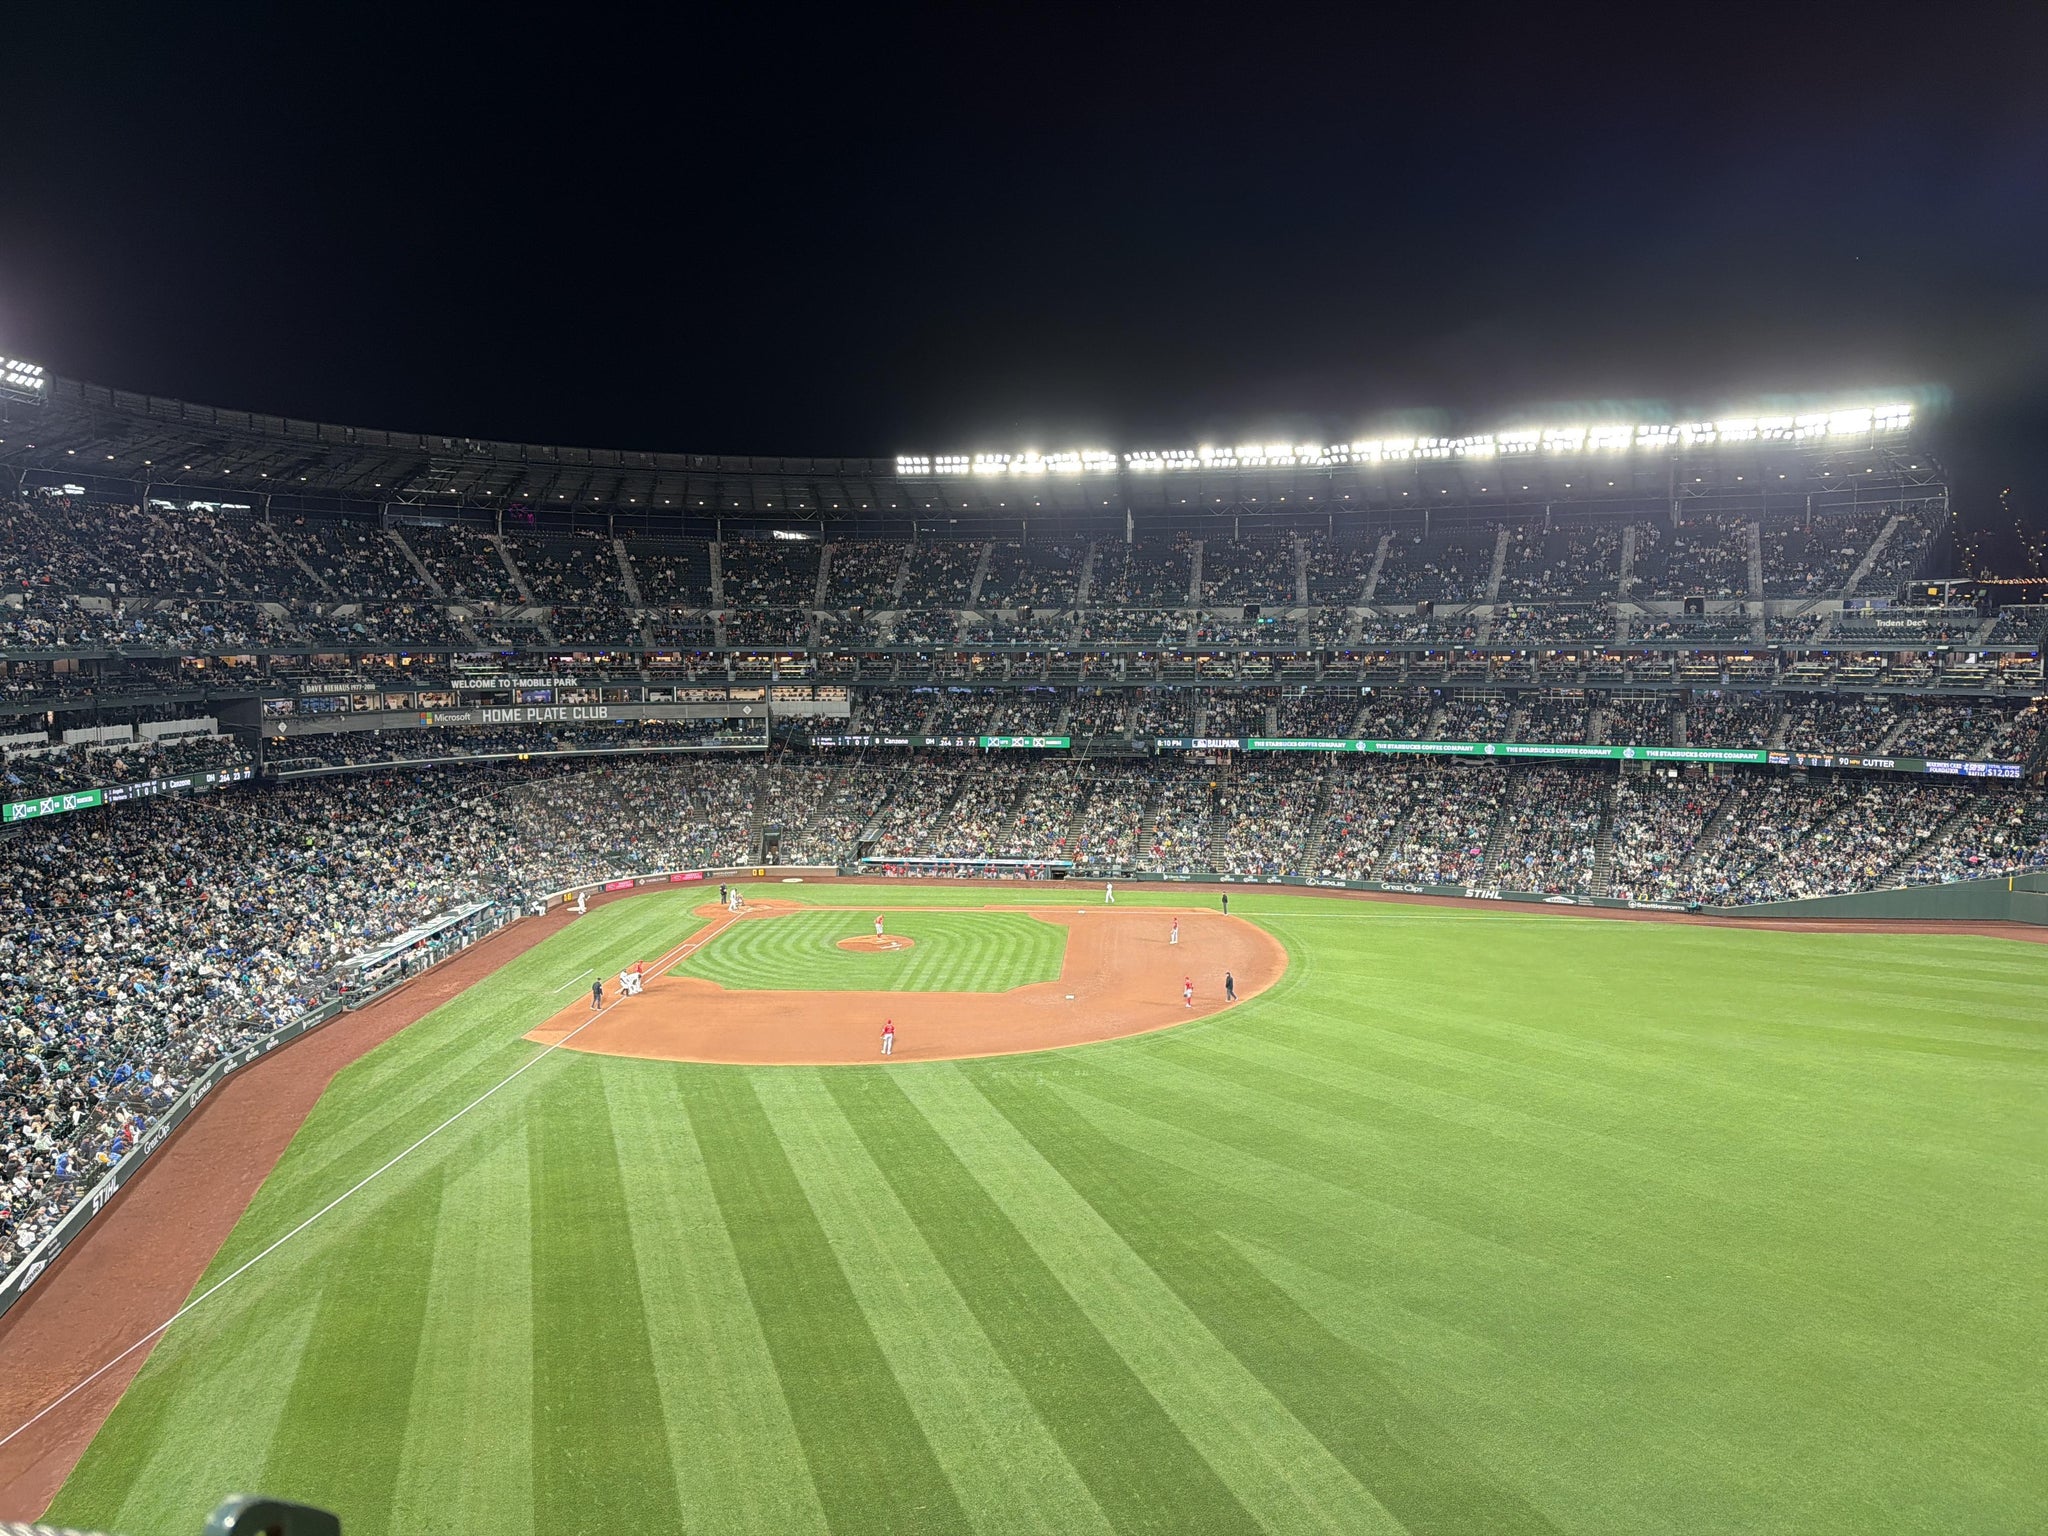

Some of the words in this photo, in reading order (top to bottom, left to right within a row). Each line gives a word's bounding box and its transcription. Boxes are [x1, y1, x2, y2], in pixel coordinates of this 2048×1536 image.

[1875, 619, 1904, 627] Trident
[306, 683, 323, 693] DAVE
[323, 683, 350, 693] NIEHAUS
[451, 679, 496, 689] WELCOME
[498, 679, 511, 688] TO
[512, 678, 552, 688] T-MOBILE
[553, 678, 578, 687] PARK
[434, 711, 471, 722] Microsoft
[482, 708, 522, 723] HOME
[527, 707, 567, 721] PLATE
[573, 706, 608, 719] CLUB
[884, 737, 909, 745] Canzone
[1207, 739, 1240, 748] BALLPARK
[1839, 757, 1849, 765] 90
[1862, 759, 1895, 768] CUTTER
[1987, 769, 2020, 778] $12,025
[1316, 879, 1346, 887] LEXUS
[1381, 882, 1403, 891] Great
[1403, 883, 1424, 893] Clips
[1464, 889, 1503, 900] STIHL
[195, 1079, 212, 1098] LEXUS
[143, 1135, 160, 1155] Great
[158, 1121, 171, 1139] Clips
[92, 1175, 120, 1217] STIHL
